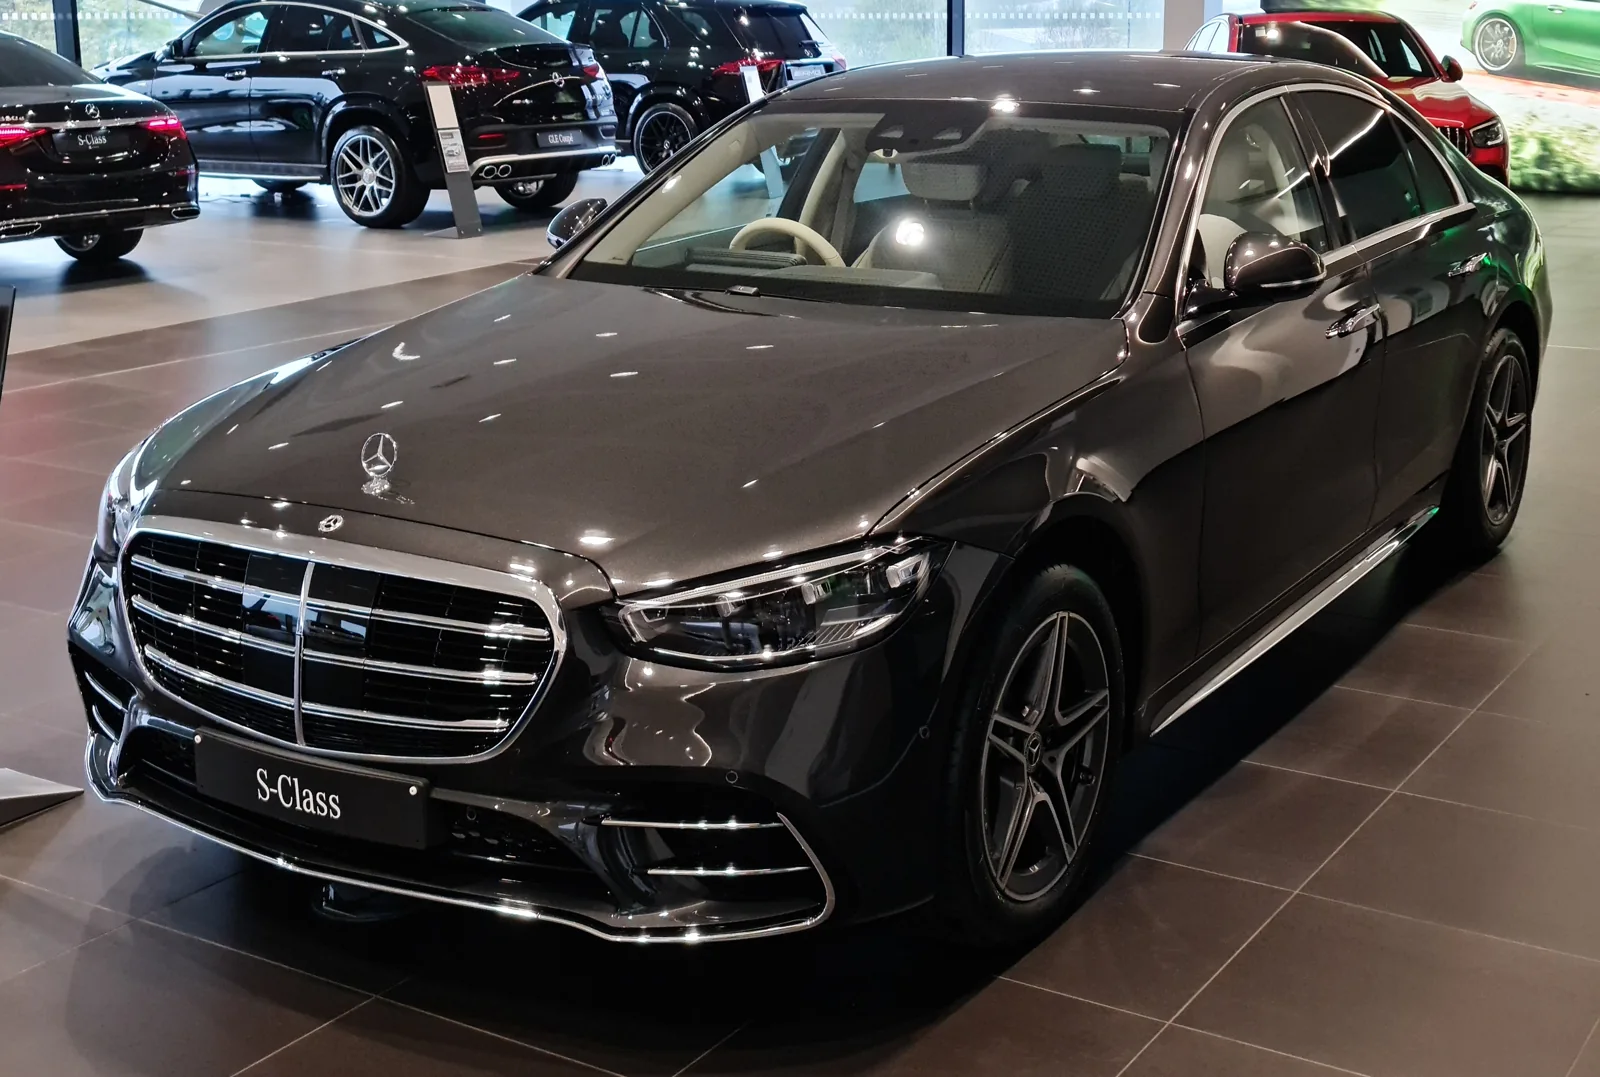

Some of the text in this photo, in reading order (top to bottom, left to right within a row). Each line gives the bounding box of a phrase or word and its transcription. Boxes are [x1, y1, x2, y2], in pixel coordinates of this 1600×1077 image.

[77, 134, 107, 146] S-Class
[548, 134, 559, 144] GLE
[256, 767, 341, 819] S-Class
